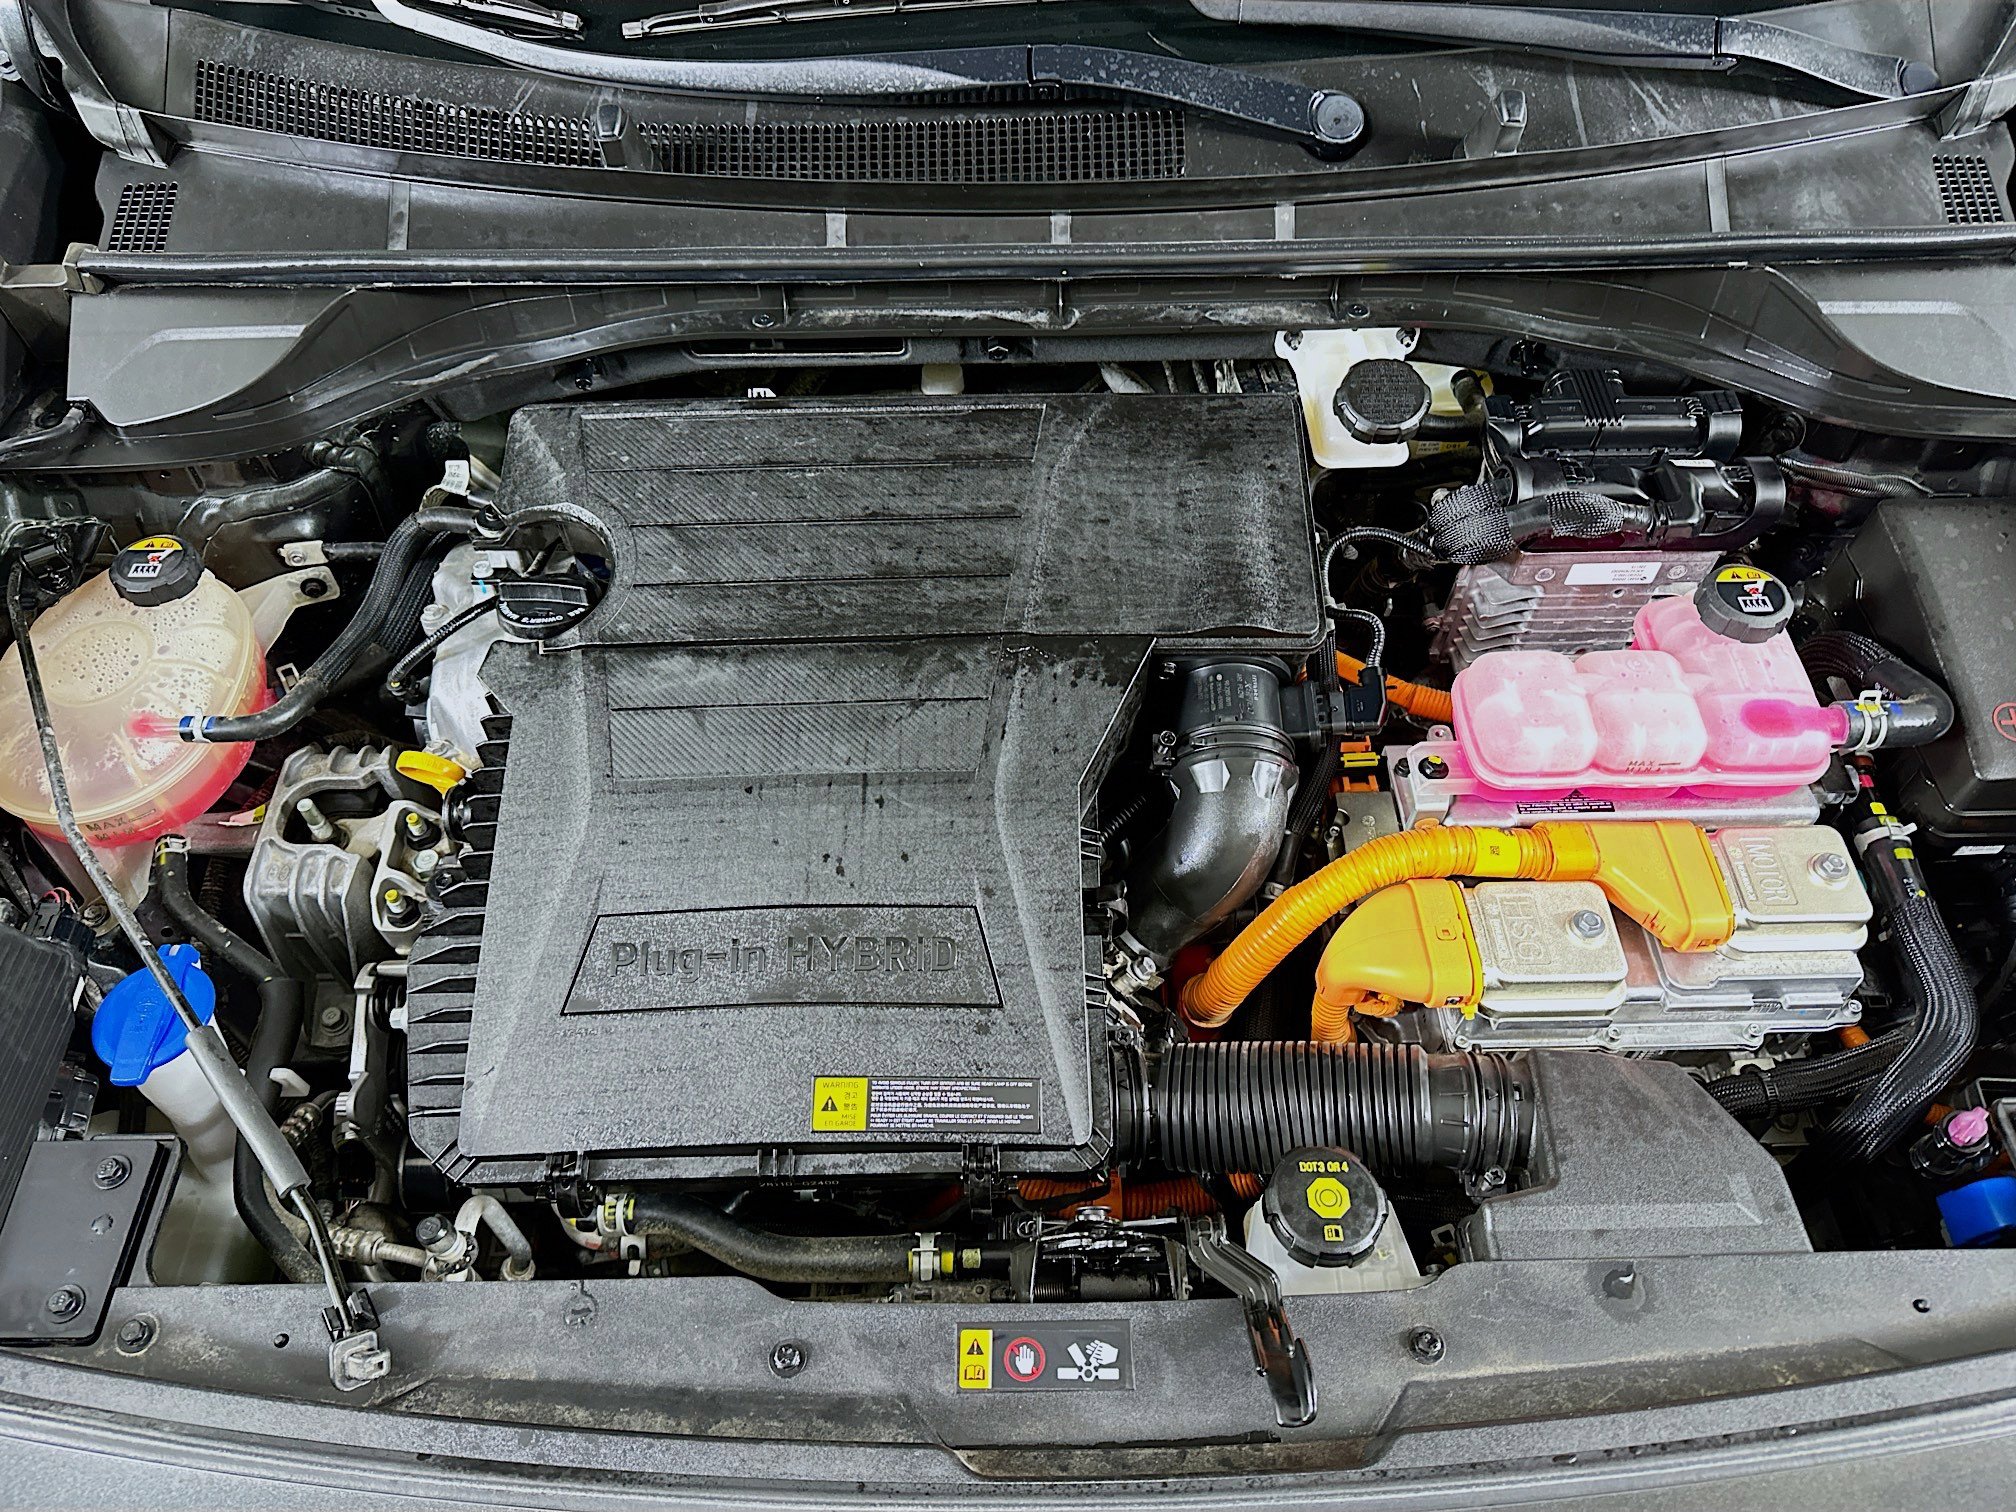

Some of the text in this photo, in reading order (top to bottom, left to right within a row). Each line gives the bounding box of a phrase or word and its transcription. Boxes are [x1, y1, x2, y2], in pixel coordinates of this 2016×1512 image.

[520, 614, 564, 624] OWNER'S
[85, 817, 127, 832] MAX
[1745, 844, 1792, 901] MOTOR
[1503, 900, 1544, 960] HSG
[610, 936, 958, 983] Plug-in HYBRID
[822, 1081, 859, 1089] WARNING
[1299, 1161, 1350, 1173] DOT3 OR 4
